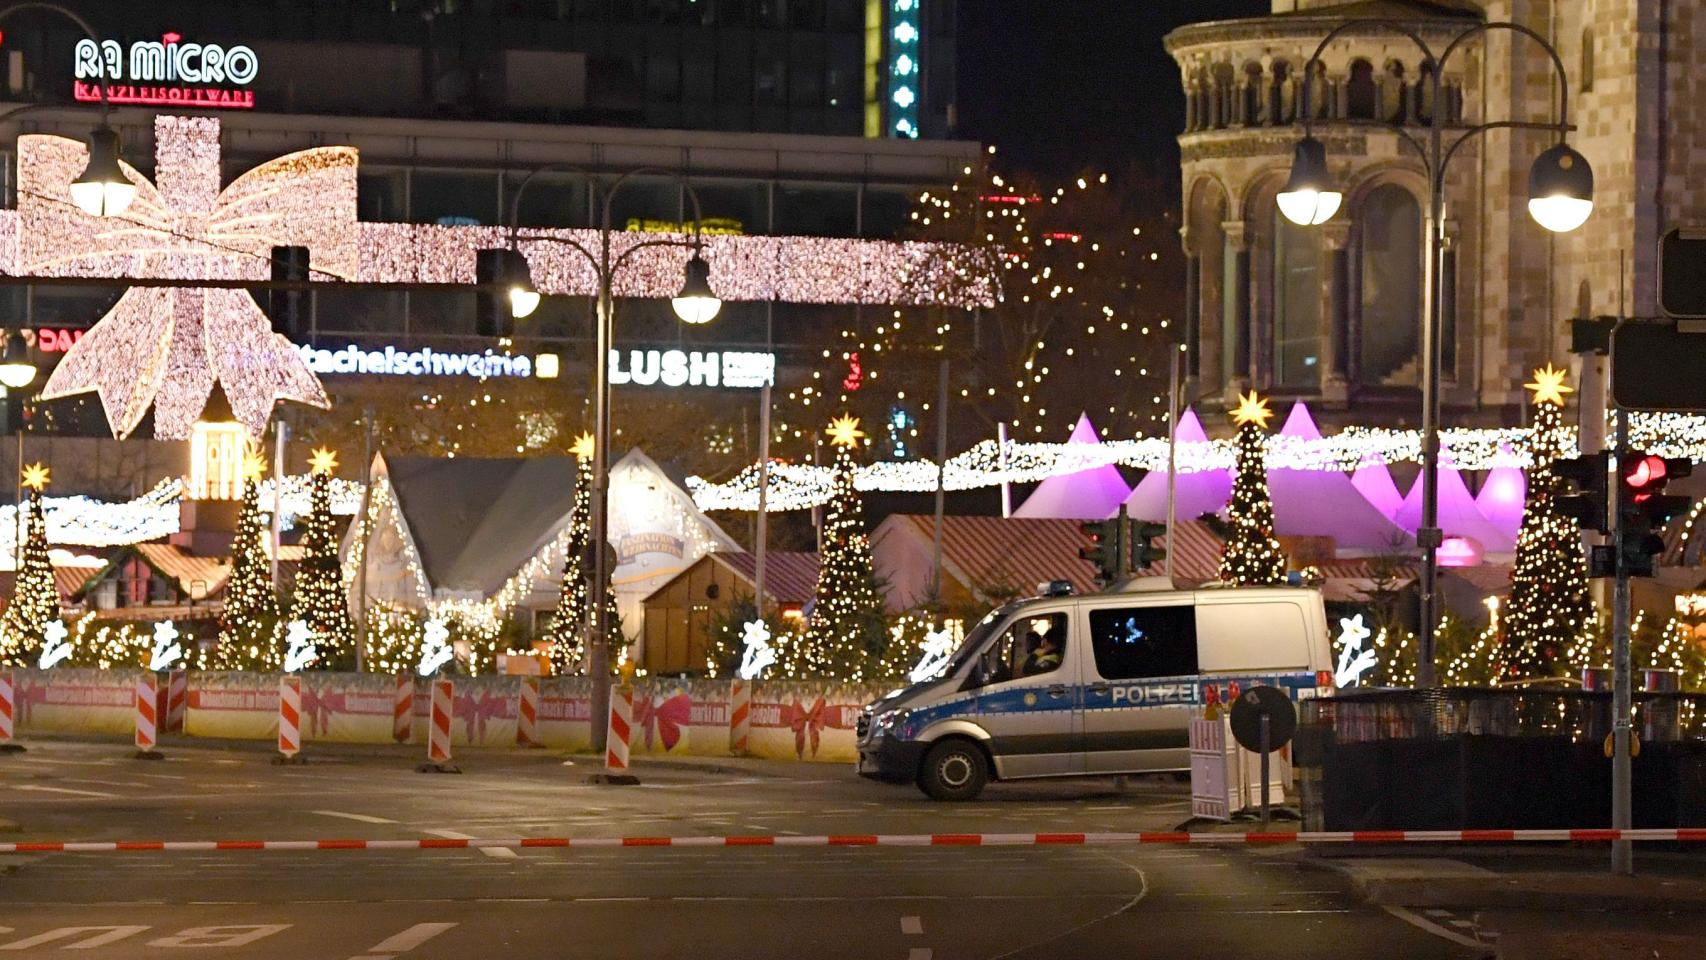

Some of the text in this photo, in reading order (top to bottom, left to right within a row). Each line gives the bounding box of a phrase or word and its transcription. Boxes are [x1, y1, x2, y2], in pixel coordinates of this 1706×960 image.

[74, 39, 258, 85] RA MICRO
[78, 84, 254, 104] KANZLEISOFTWARE
[293, 343, 531, 377] tachelschweine
[608, 350, 719, 387] LUSH
[1112, 683, 1198, 704] POLIZEI
